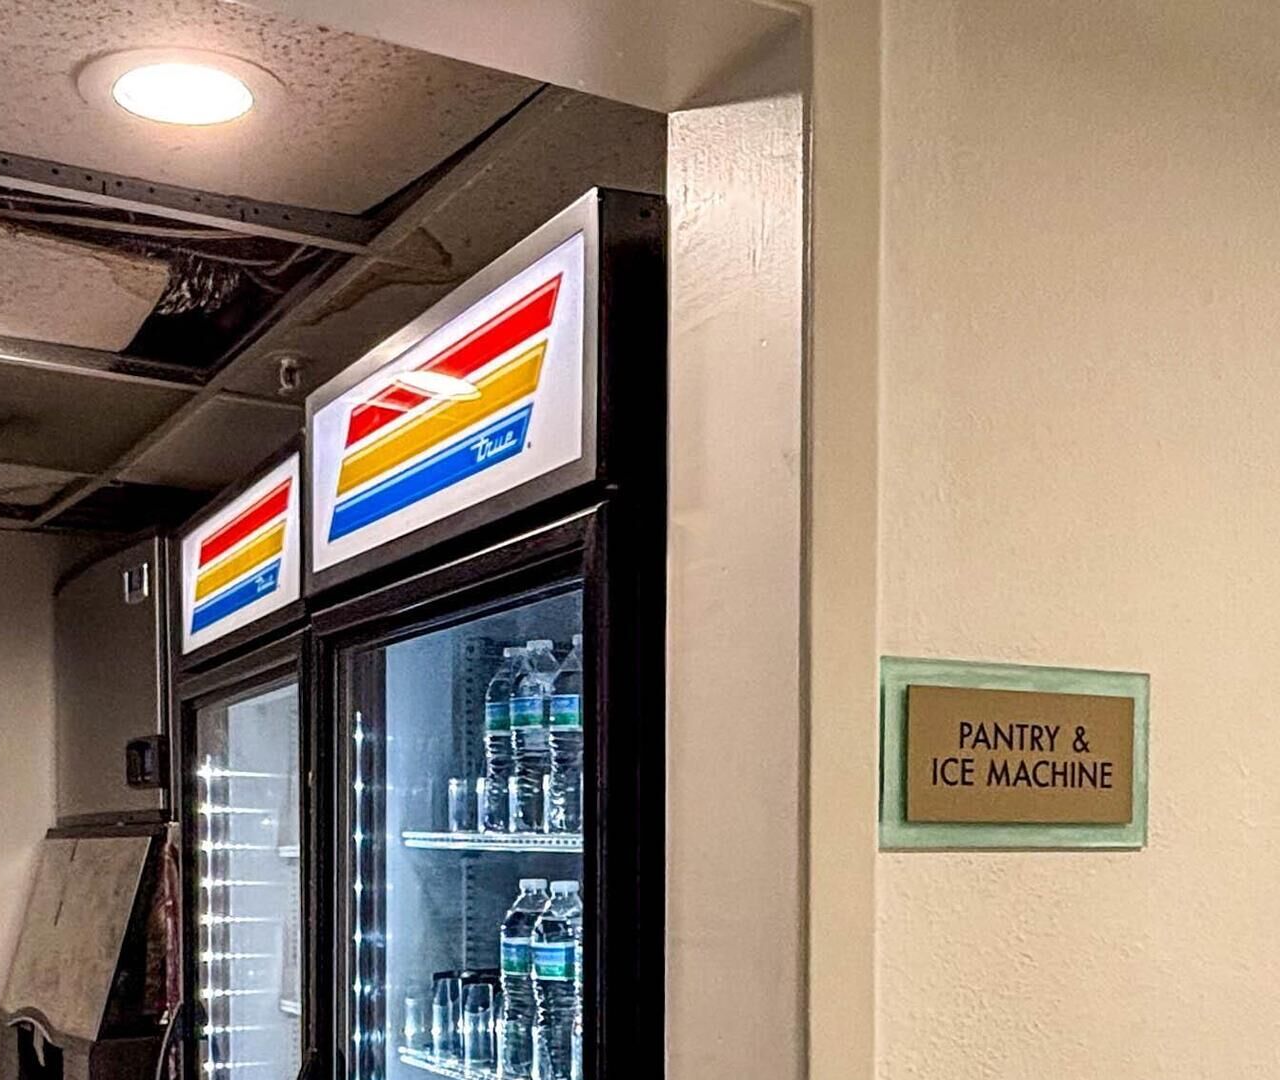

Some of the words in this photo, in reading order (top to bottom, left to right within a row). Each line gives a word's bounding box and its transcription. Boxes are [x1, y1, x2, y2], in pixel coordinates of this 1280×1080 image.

[959, 721, 1060, 751] PANTRY
[1072, 725, 1090, 752] &
[932, 758, 974, 786] ICE
[986, 760, 1113, 788] MACHINE
